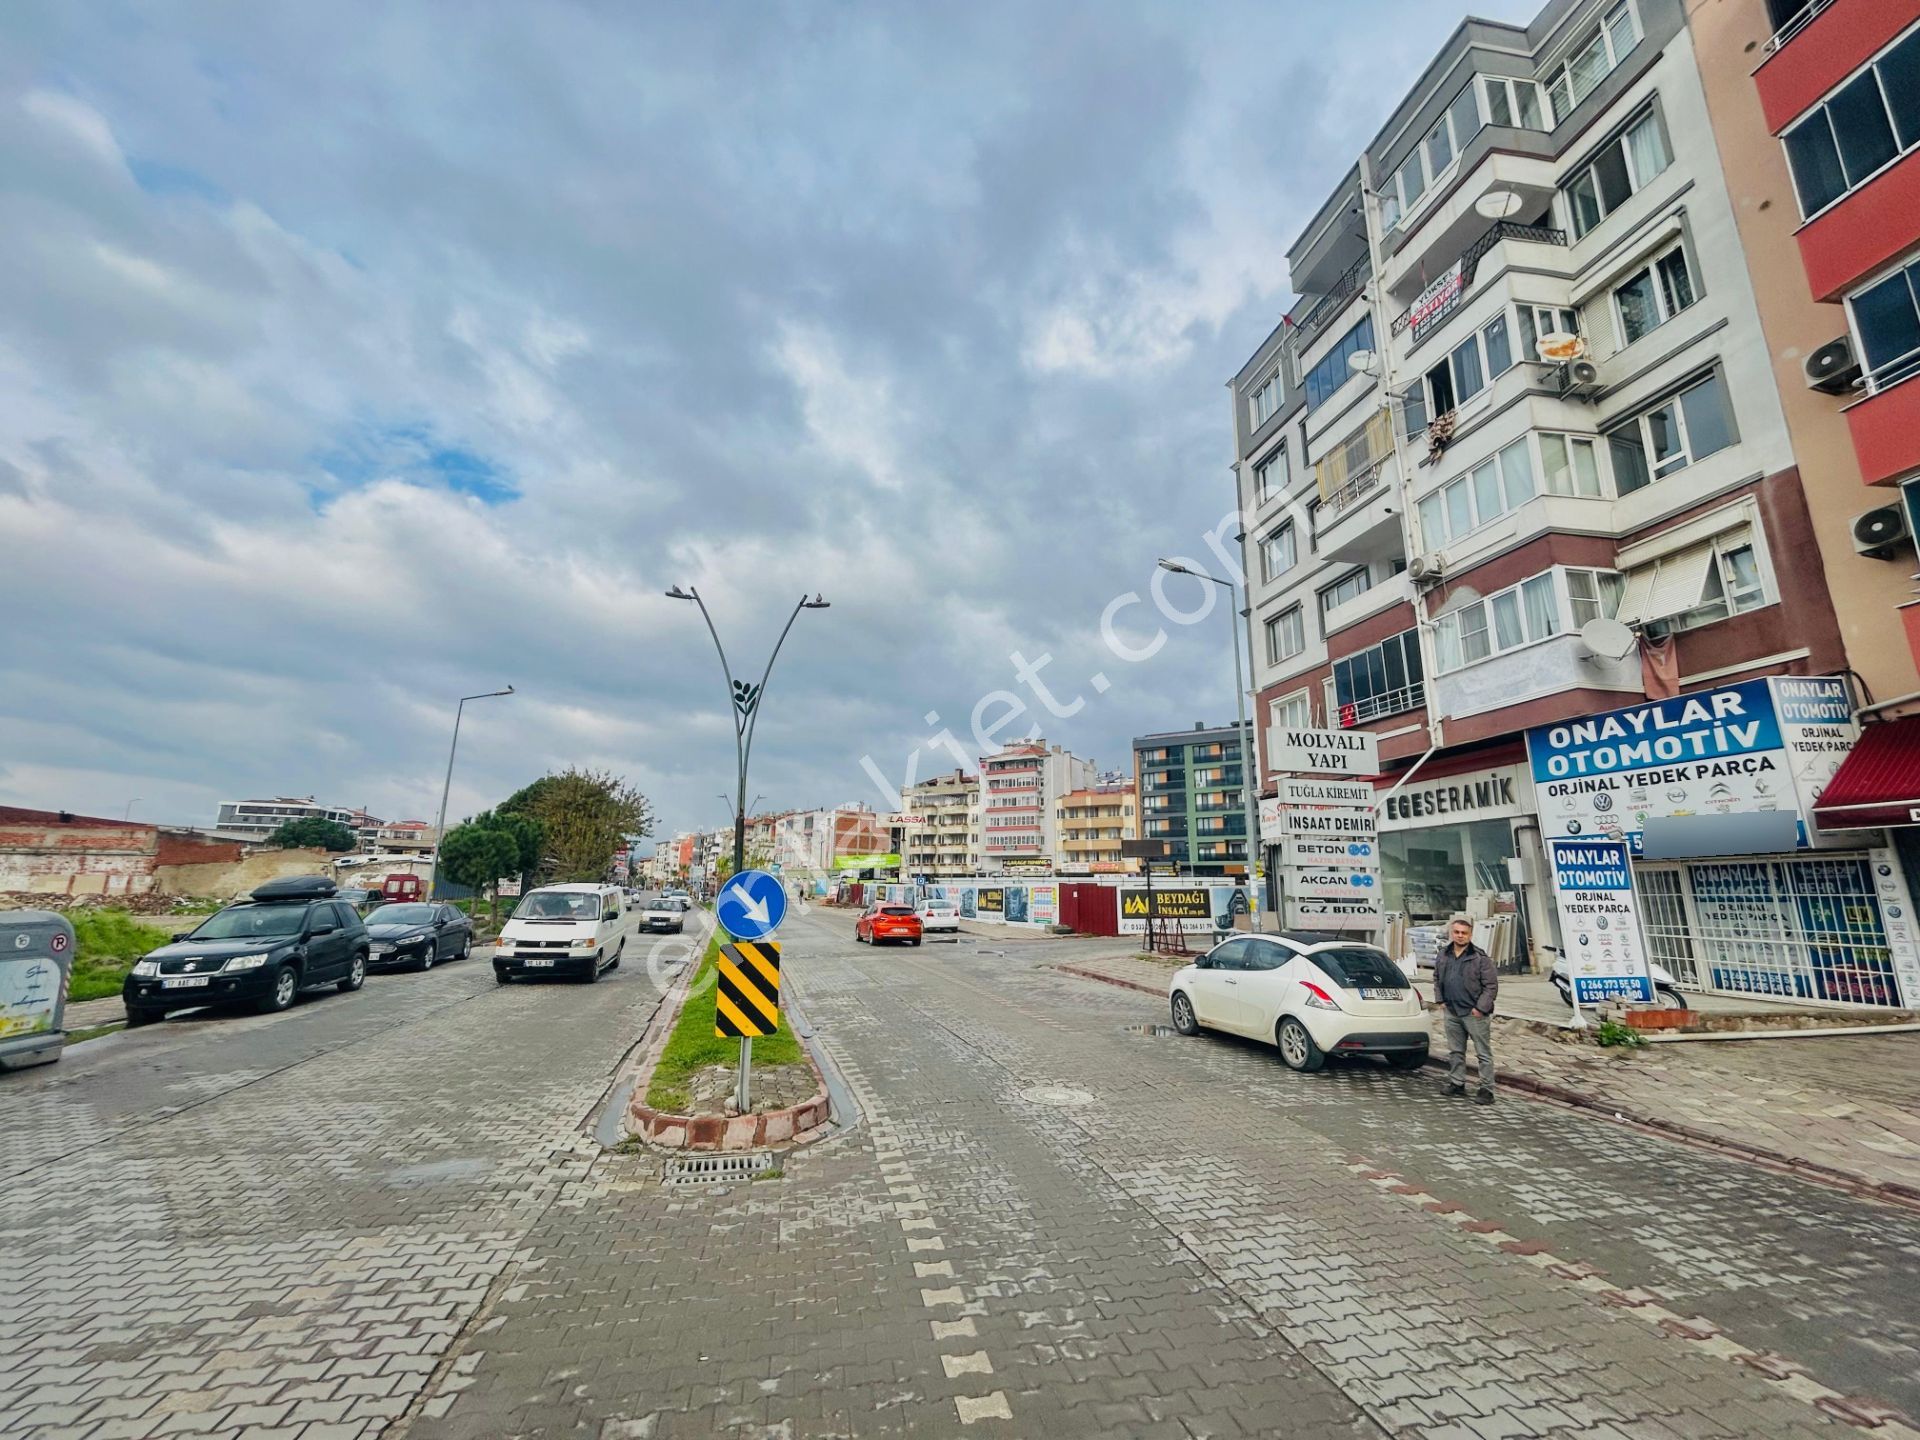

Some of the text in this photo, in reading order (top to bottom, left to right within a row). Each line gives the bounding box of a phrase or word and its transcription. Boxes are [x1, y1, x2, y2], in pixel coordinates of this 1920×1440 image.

[1780, 682, 1843, 698] ONAYLAR
[1783, 699, 1849, 719] OTOMOTİV
[1548, 691, 1747, 749] ONAYLAR
[1801, 725, 1844, 738] ORJİNAL
[1286, 732, 1366, 751] MOLVALI
[1547, 720, 1761, 777] OTOMOTİV
[1792, 741, 1825, 752] YEDEK
[1307, 752, 1348, 769] YAPI
[1548, 756, 1776, 798] ORJİNAL YEDEK PARÇA
[1288, 785, 1369, 800] TUĞLA KİREMİT
[1386, 773, 1515, 820] EGESERAMİK
[889, 815, 927, 824] LASSA
[1289, 813, 1332, 831] İNŞAAT
[1335, 815, 1376, 832] DEMİRİ
[1297, 844, 1345, 854] BETON
[1557, 849, 1621, 866] ONAYLAR
[1300, 875, 1348, 885] AKCAN
[1558, 867, 1626, 887] OTOMOTİV
[1156, 891, 1205, 905] BEYDAĞI
[1333, 906, 1377, 914] BETON
[1565, 904, 1596, 913] YEDEK
[1580, 980, 1586, 989] 0
[1587, 980, 1603, 989] 266
[1603, 979, 1619, 989] 373
[1582, 990, 1588, 1000] 0
[1590, 990, 1604, 1000] 530
